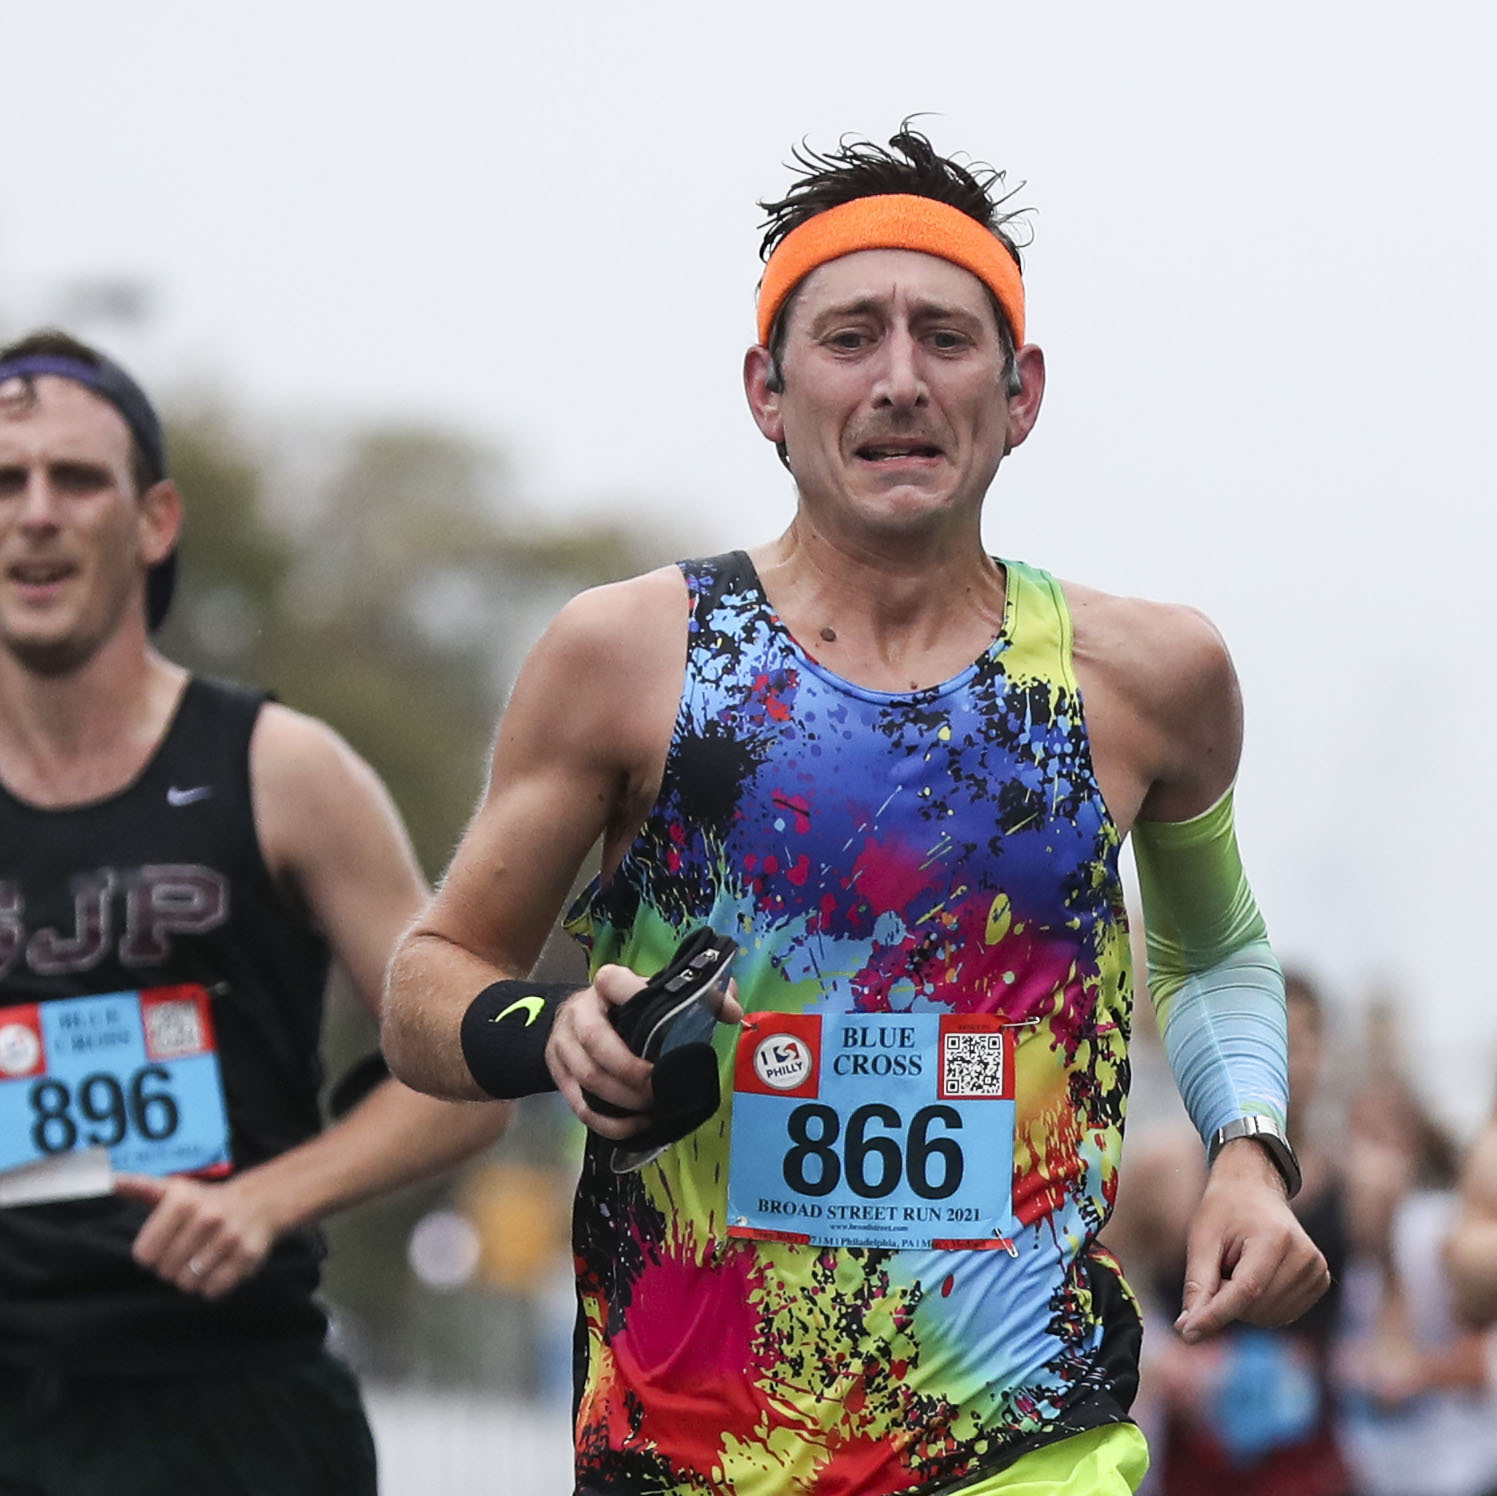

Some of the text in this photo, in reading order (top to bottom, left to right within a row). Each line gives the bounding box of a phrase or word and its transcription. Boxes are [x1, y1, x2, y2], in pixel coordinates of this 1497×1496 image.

[842, 1026, 915, 1049] BLUE
[766, 1061, 803, 1079] PHILLY
[833, 1053, 923, 1076] CROSS
[28, 1065, 179, 1154] 896
[782, 1103, 964, 1200] 866
[758, 1198, 980, 1222] BROAD STREET RUN 2021
